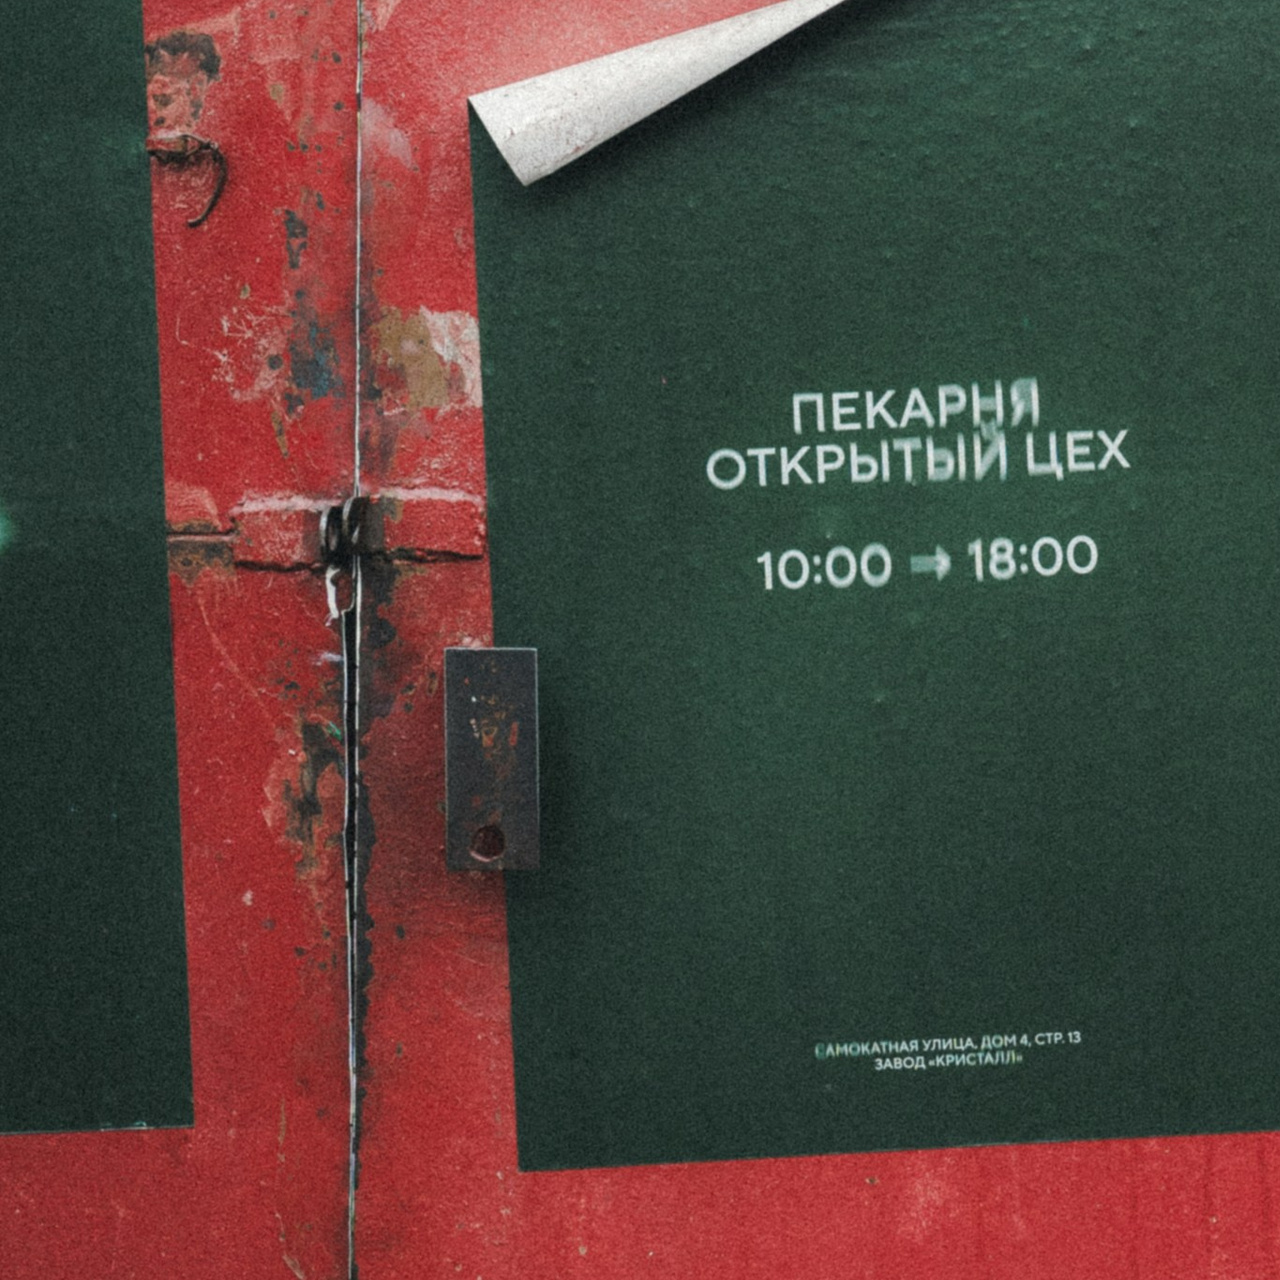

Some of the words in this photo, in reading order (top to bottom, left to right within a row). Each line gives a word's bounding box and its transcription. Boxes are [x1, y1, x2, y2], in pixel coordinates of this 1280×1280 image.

[792, 376, 1040, 435] ПЕКАРНЯ
[706, 419, 1007, 490] ОТКРЫТЫЙ
[1026, 429, 1131, 481] ЦЕХ
[757, 543, 893, 590] 10:00
[967, 535, 1099, 582] 18:00
[815, 1039, 919, 1060] САМОКАТНАЯ
[981, 1033, 1017, 1050] ДОМ
[1019, 1033, 1032, 1048] 4,
[1034, 1032, 1066, 1046] СТР.
[1067, 1031, 1082, 1044] 13
[874, 1055, 926, 1071] ЗАВОД
[928, 1049, 1023, 1068] «КРИСТАЛЛ»
